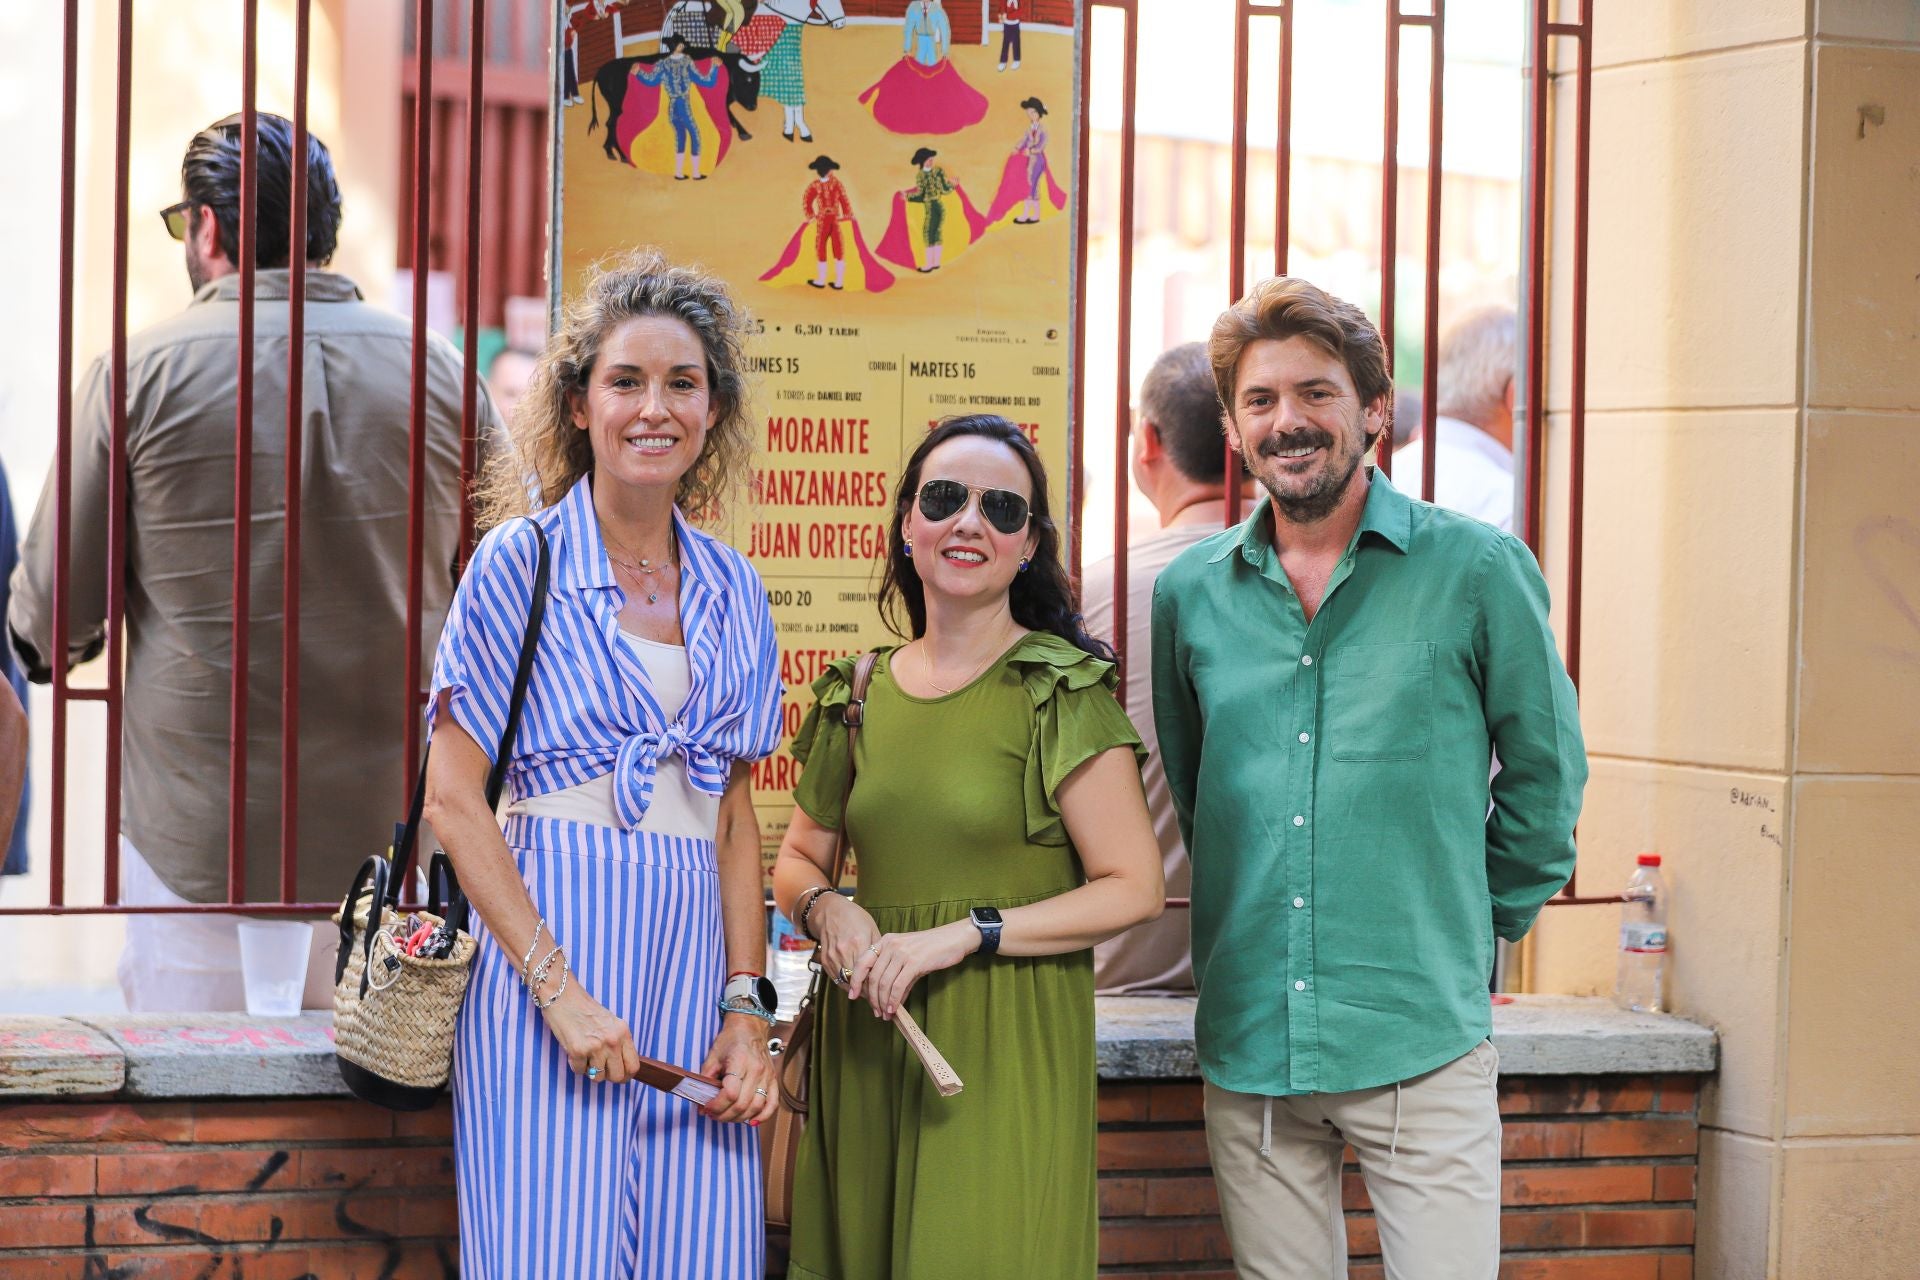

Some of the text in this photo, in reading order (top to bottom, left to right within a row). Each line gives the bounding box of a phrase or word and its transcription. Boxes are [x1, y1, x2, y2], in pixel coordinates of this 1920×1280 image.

[828, 327, 860, 337] TARDE
[786, 357, 799, 374] 15
[868, 360, 898, 372] CORRIDA
[910, 360, 976, 379] MARTES 16
[1032, 365, 1061, 377] CORRIDA
[784, 390, 806, 401] TOROS
[817, 391, 843, 401] DANIEL
[845, 392, 863, 402] RUIZ
[936, 395, 958, 405] TOROS
[968, 395, 1012, 406] VICTORIANO
[1013, 396, 1026, 406] DEL
[767, 416, 870, 455] MORANTE
[748, 469, 888, 507] MANZANARES
[747, 522, 888, 560] JUAN ORTEGA
[796, 590, 812, 606] 20
[838, 591, 867, 603] CORRIDA
[781, 623, 803, 634] TOROS
